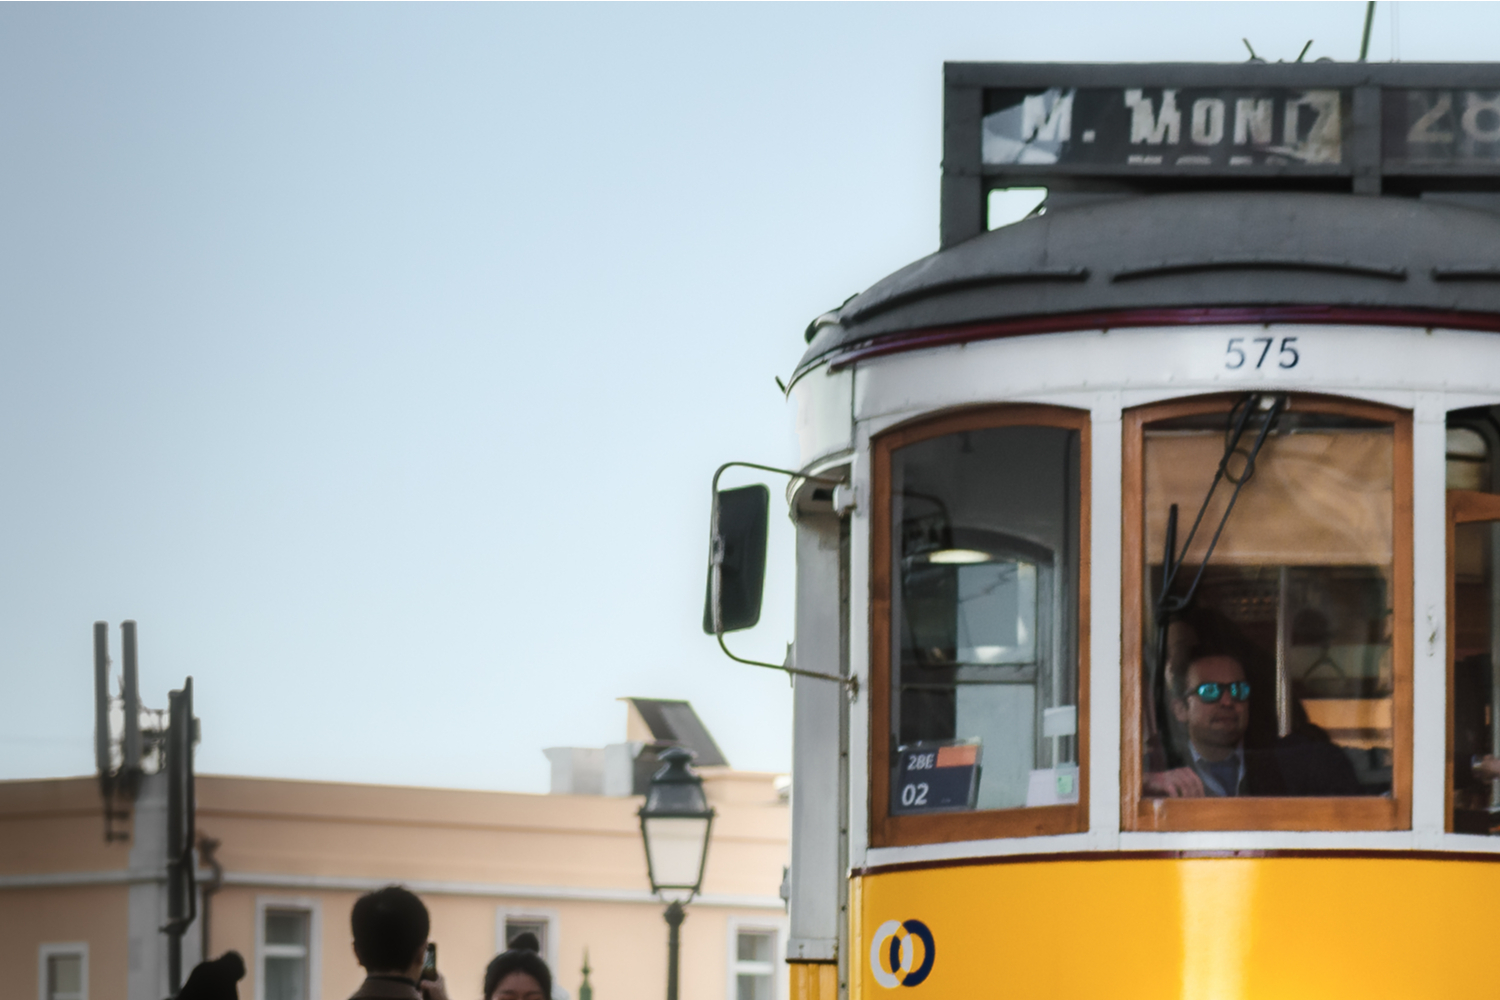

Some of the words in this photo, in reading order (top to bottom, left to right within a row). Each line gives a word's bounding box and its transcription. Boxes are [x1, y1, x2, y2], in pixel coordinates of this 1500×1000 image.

[1224, 336, 1300, 370] 575
[907, 753, 936, 771] 28E
[902, 782, 930, 806] 02
